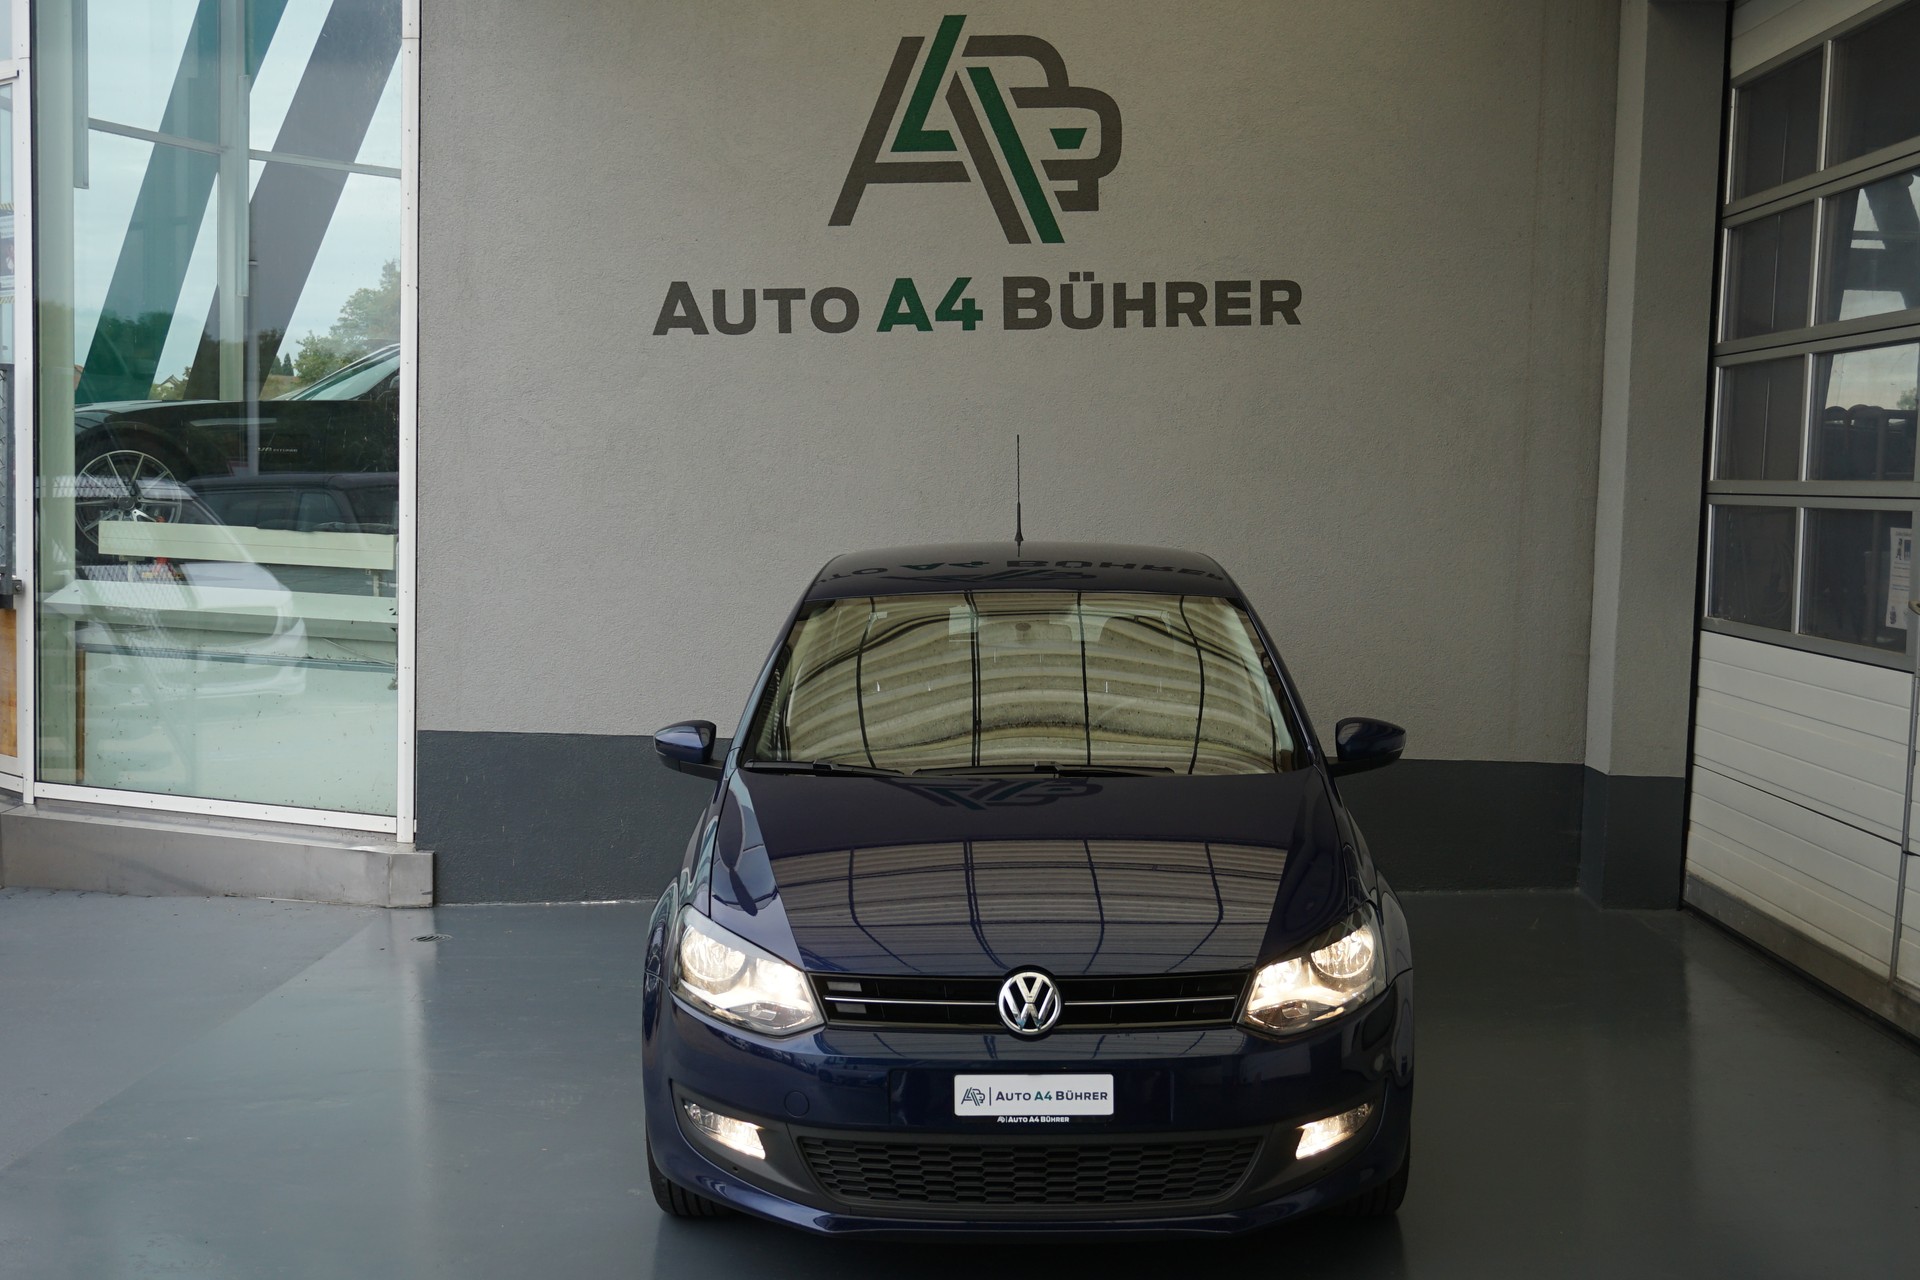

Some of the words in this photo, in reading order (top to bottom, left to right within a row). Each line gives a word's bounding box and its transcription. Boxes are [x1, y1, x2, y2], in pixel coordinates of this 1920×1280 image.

[652, 281, 860, 336] AUTO
[876, 277, 984, 333] A4
[1002, 271, 1303, 331] BÜHRER
[995, 1090, 1032, 1101] AUTO
[1034, 1091, 1053, 1101] A4
[1055, 1090, 1108, 1101] BÜHRER
